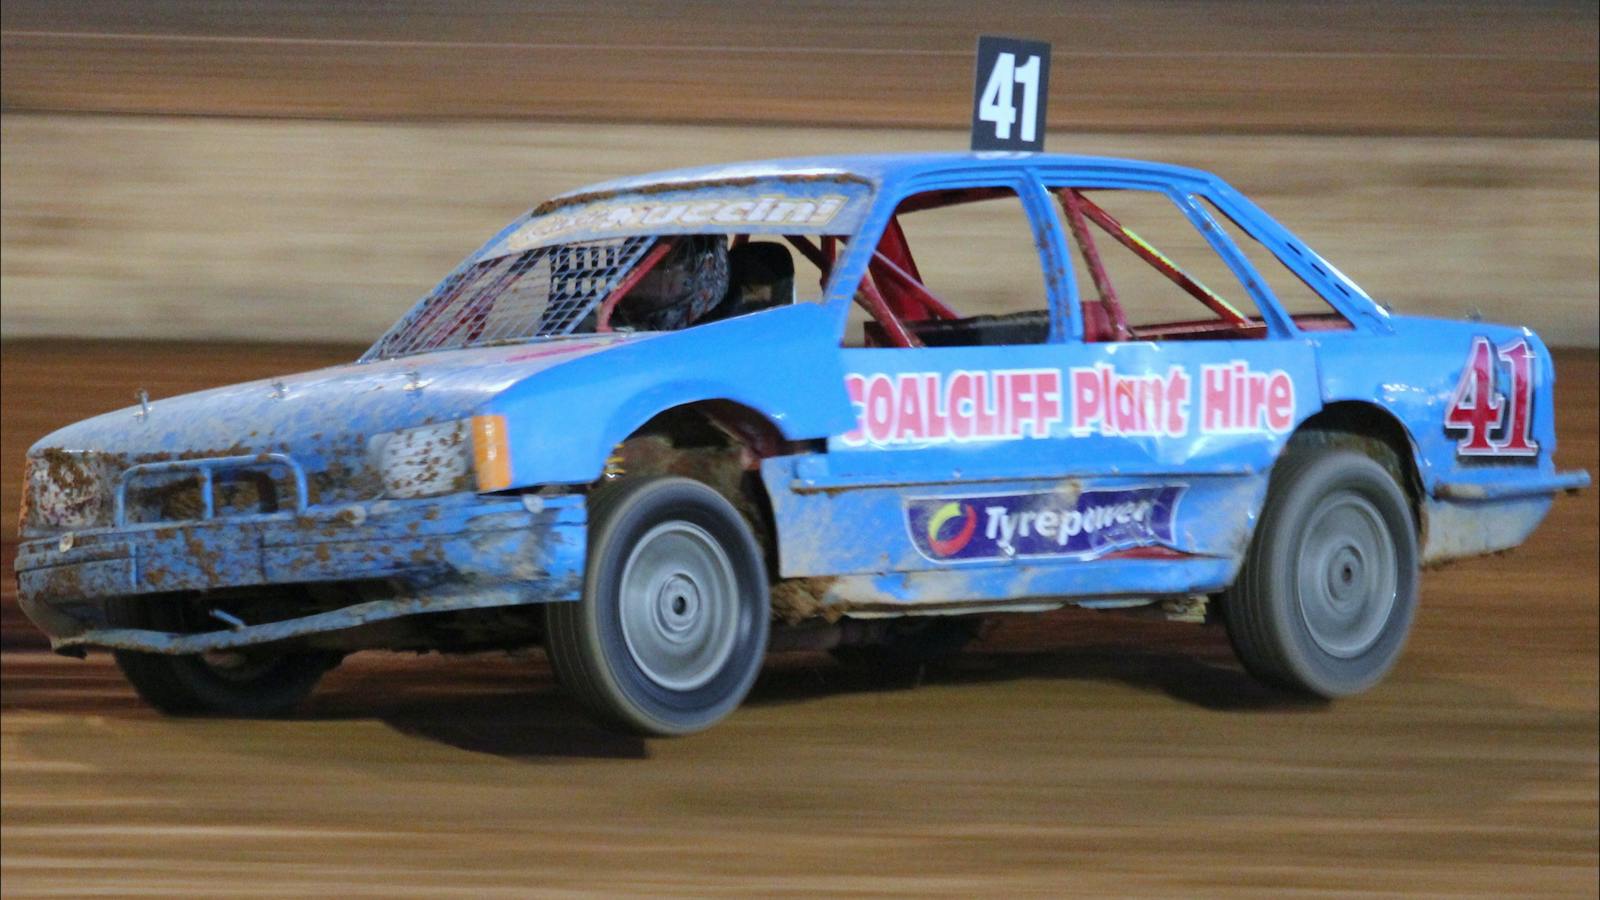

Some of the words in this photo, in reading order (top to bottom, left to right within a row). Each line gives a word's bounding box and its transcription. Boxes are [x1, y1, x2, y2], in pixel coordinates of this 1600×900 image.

[979, 51, 1041, 142] 41
[1070, 362, 1191, 437] Plant
[1202, 360, 1295, 433] Hire
[1445, 336, 1538, 456] 41
